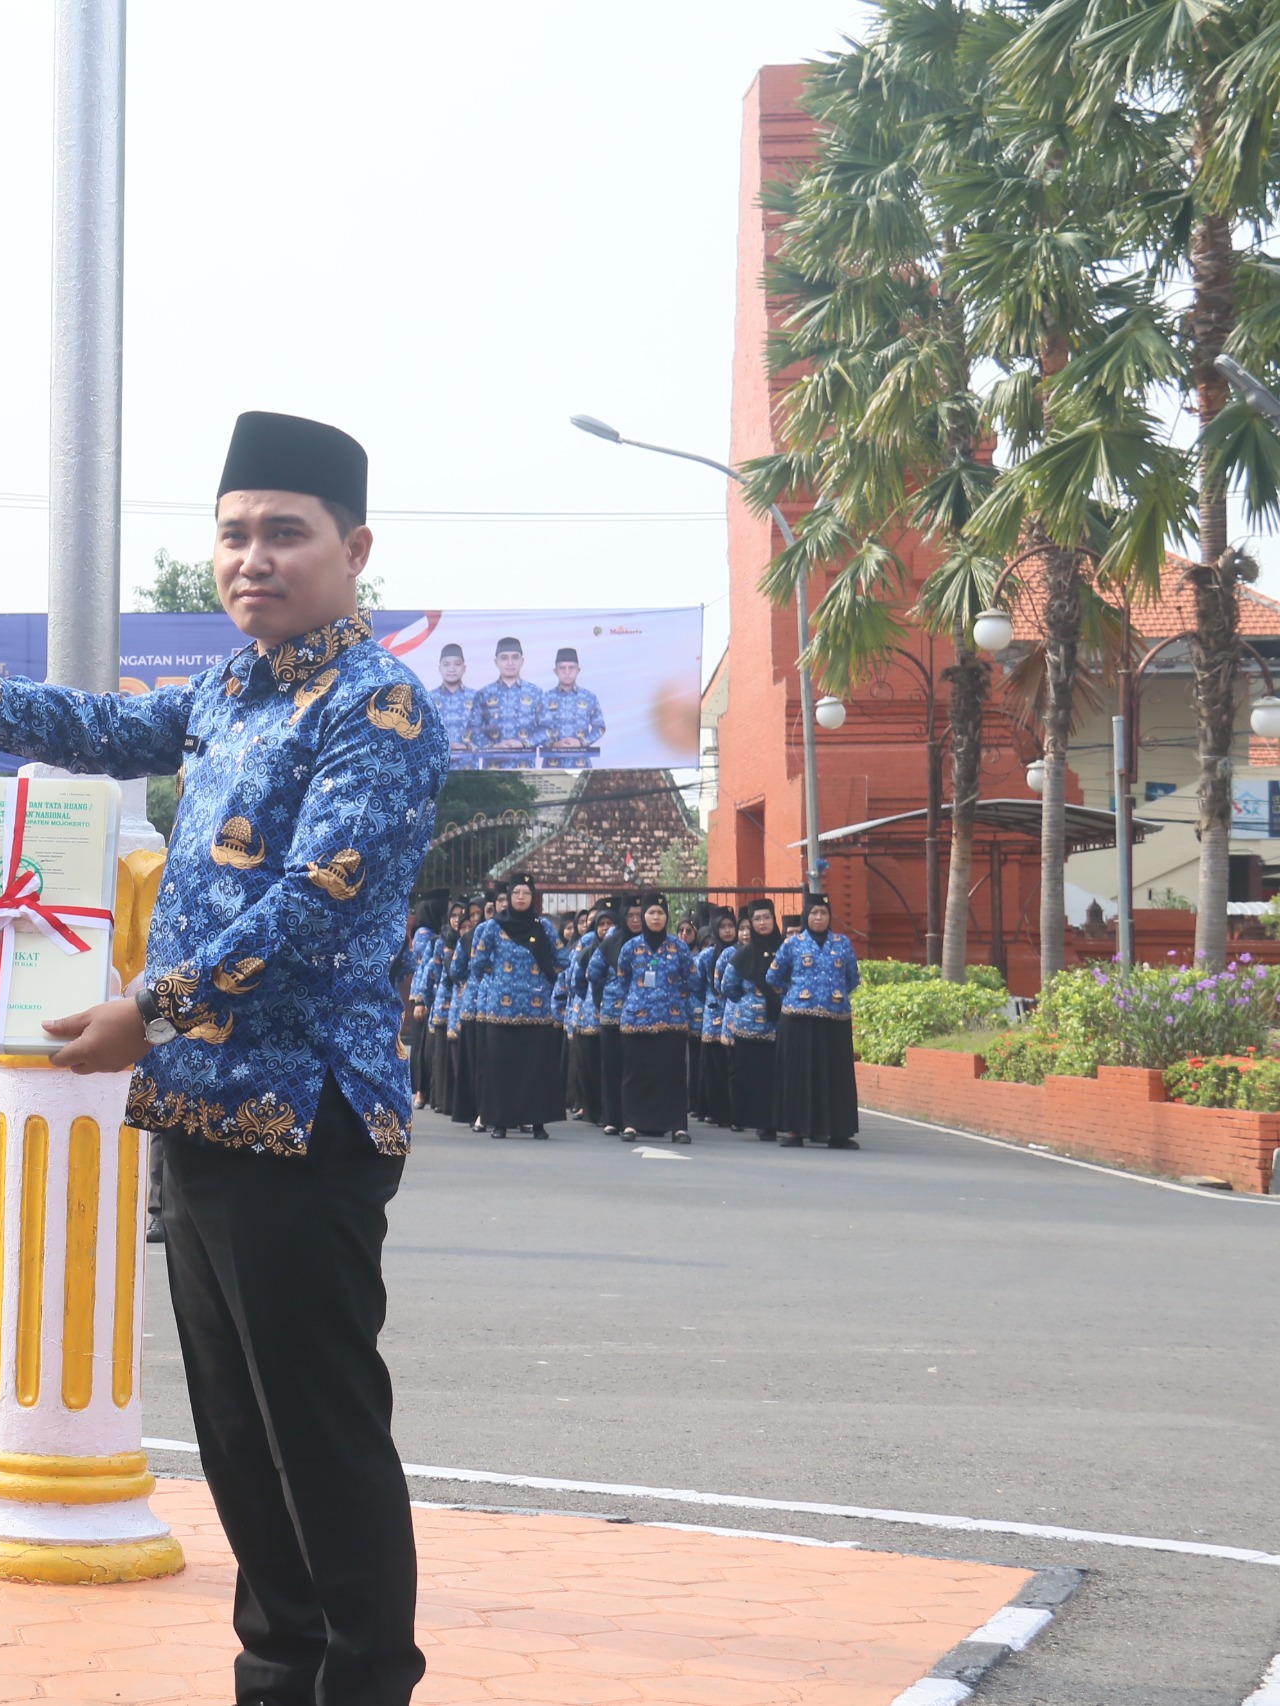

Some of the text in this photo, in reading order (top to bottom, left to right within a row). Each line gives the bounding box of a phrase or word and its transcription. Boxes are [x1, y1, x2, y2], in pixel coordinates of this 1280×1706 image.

[119, 655, 224, 666] NGATAN HUT KE
[28, 801, 43, 809] DAN
[35, 811, 71, 820] NASIONAL
